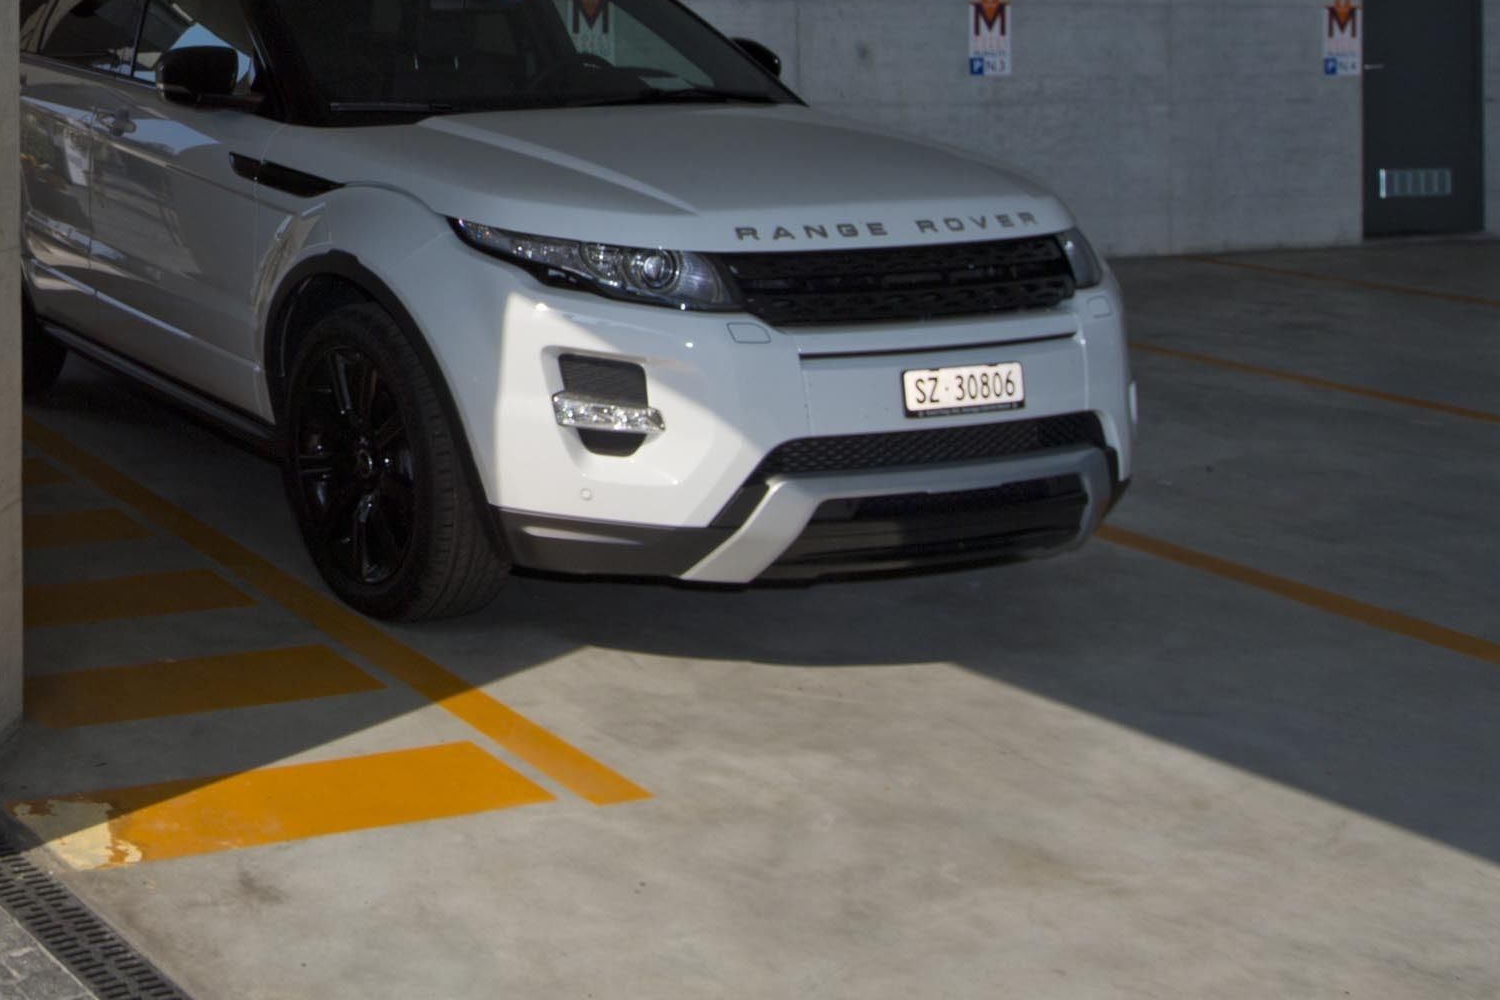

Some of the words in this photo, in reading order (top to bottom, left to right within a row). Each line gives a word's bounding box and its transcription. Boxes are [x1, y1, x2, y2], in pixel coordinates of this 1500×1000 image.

[969, 2, 1010, 37] M
[1324, 5, 1362, 38] M
[734, 222, 888, 241] RANGE
[915, 211, 1040, 233] ROVER
[955, 369, 1016, 401] 30806
